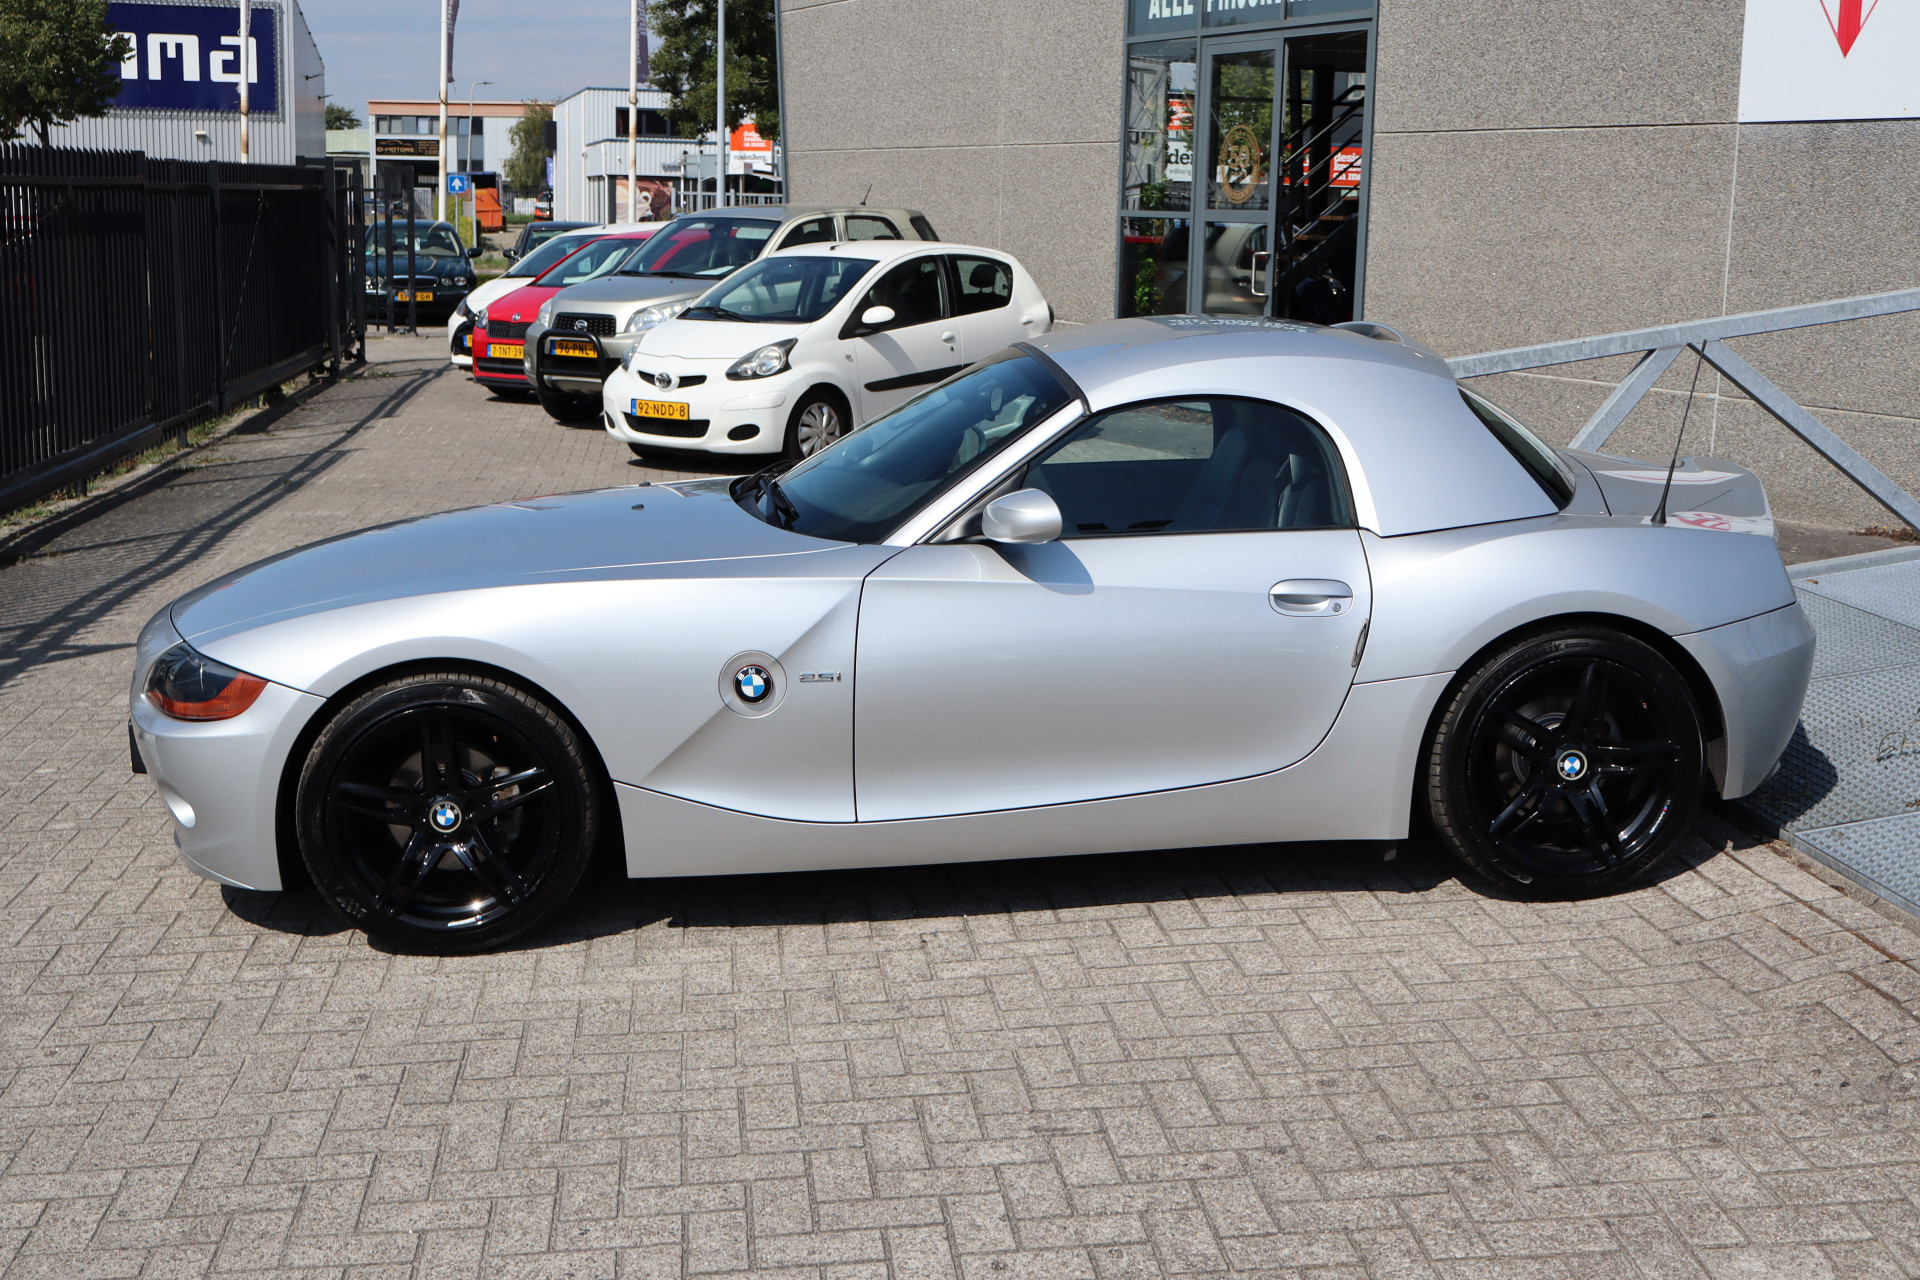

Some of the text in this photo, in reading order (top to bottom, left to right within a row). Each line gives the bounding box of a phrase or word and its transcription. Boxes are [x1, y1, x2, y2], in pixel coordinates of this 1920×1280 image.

[492, 346, 523, 357] 7-TNT-39
[638, 401, 686, 418] 92-NDD-8
[737, 667, 768, 682] BMW
[435, 803, 459, 814] BMW
